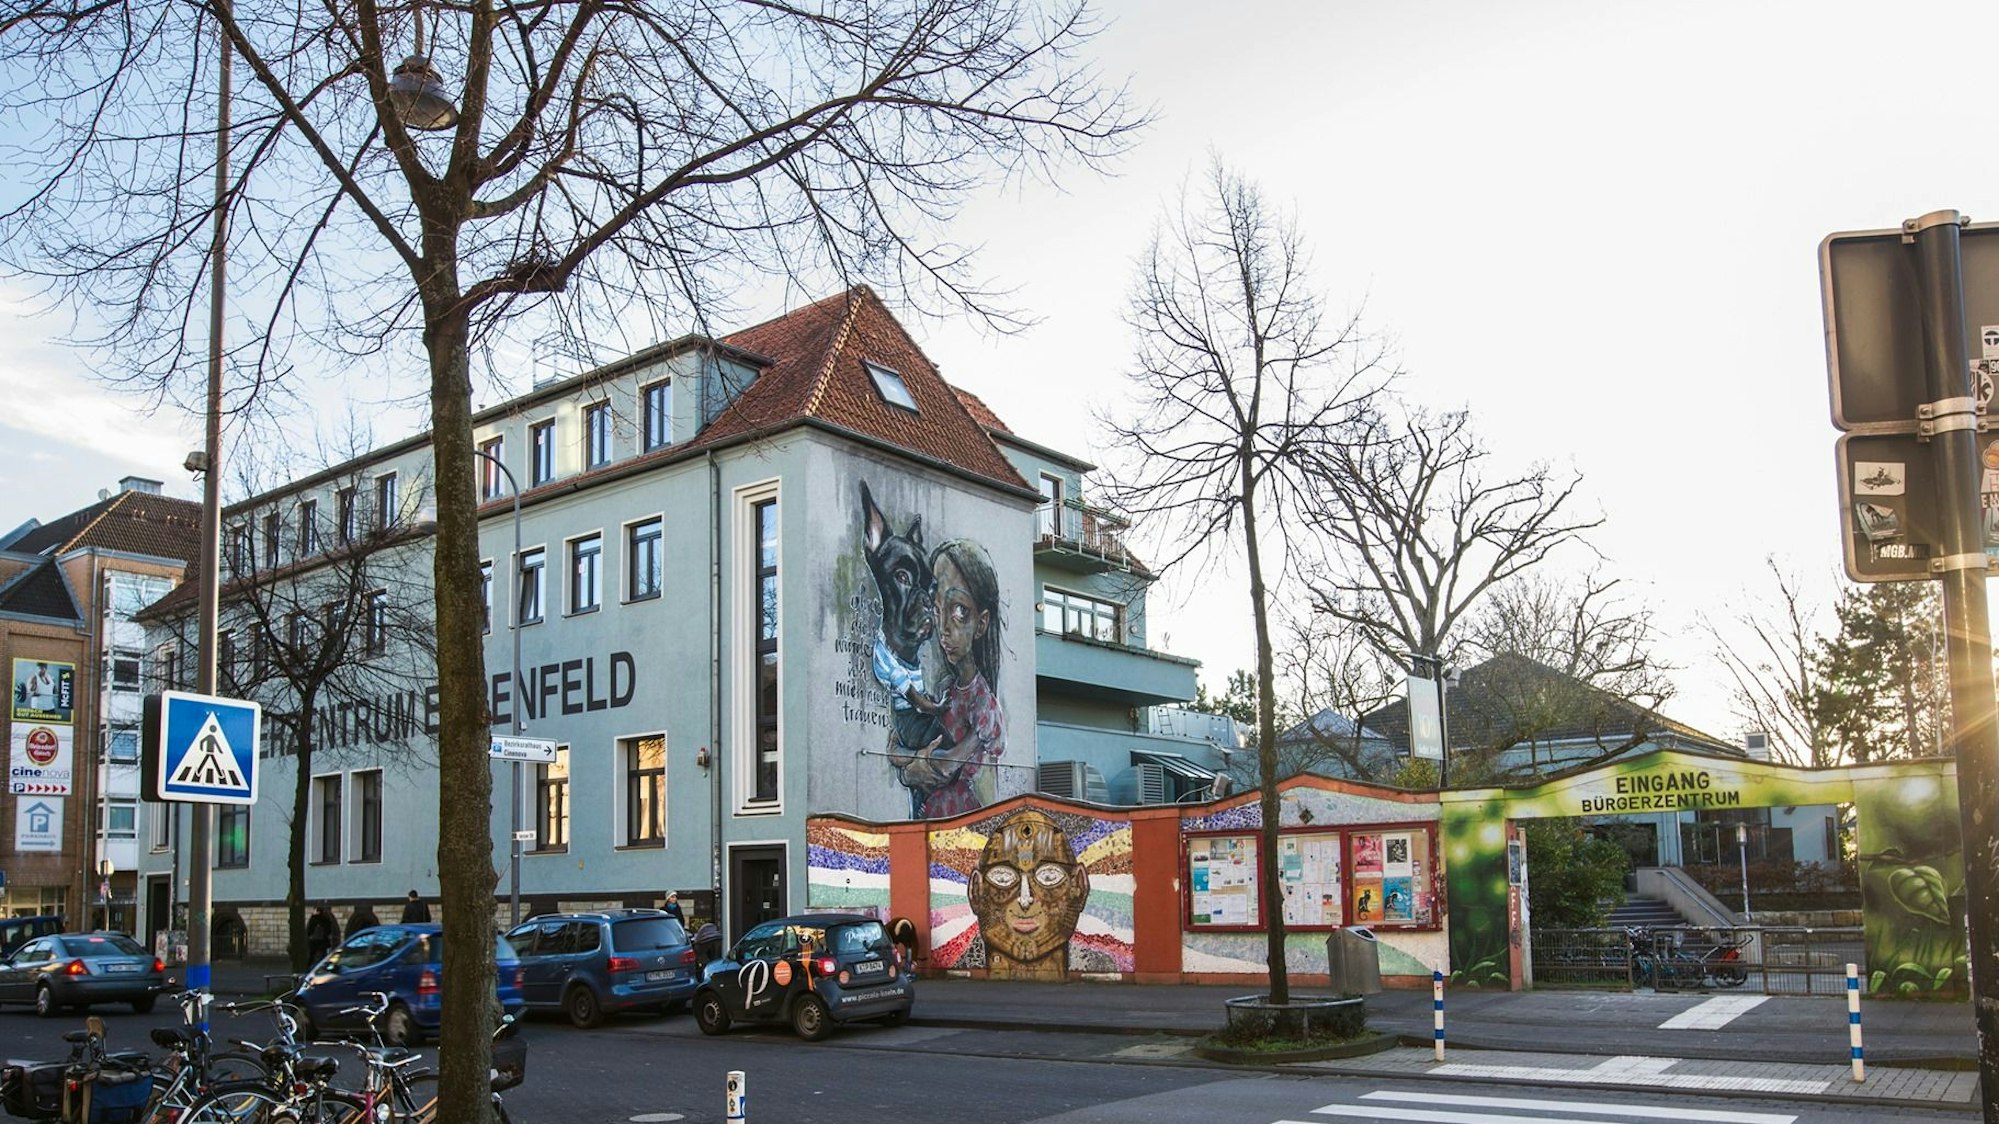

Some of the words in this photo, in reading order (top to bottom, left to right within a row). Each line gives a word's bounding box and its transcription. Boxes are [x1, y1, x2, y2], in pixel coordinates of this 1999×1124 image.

[425, 651, 636, 734] EENFELD
[12, 766, 70, 778] cinenova
[1616, 772, 1710, 794] EINGANG
[1582, 791, 1740, 812] BÜRGERZENTRUM
